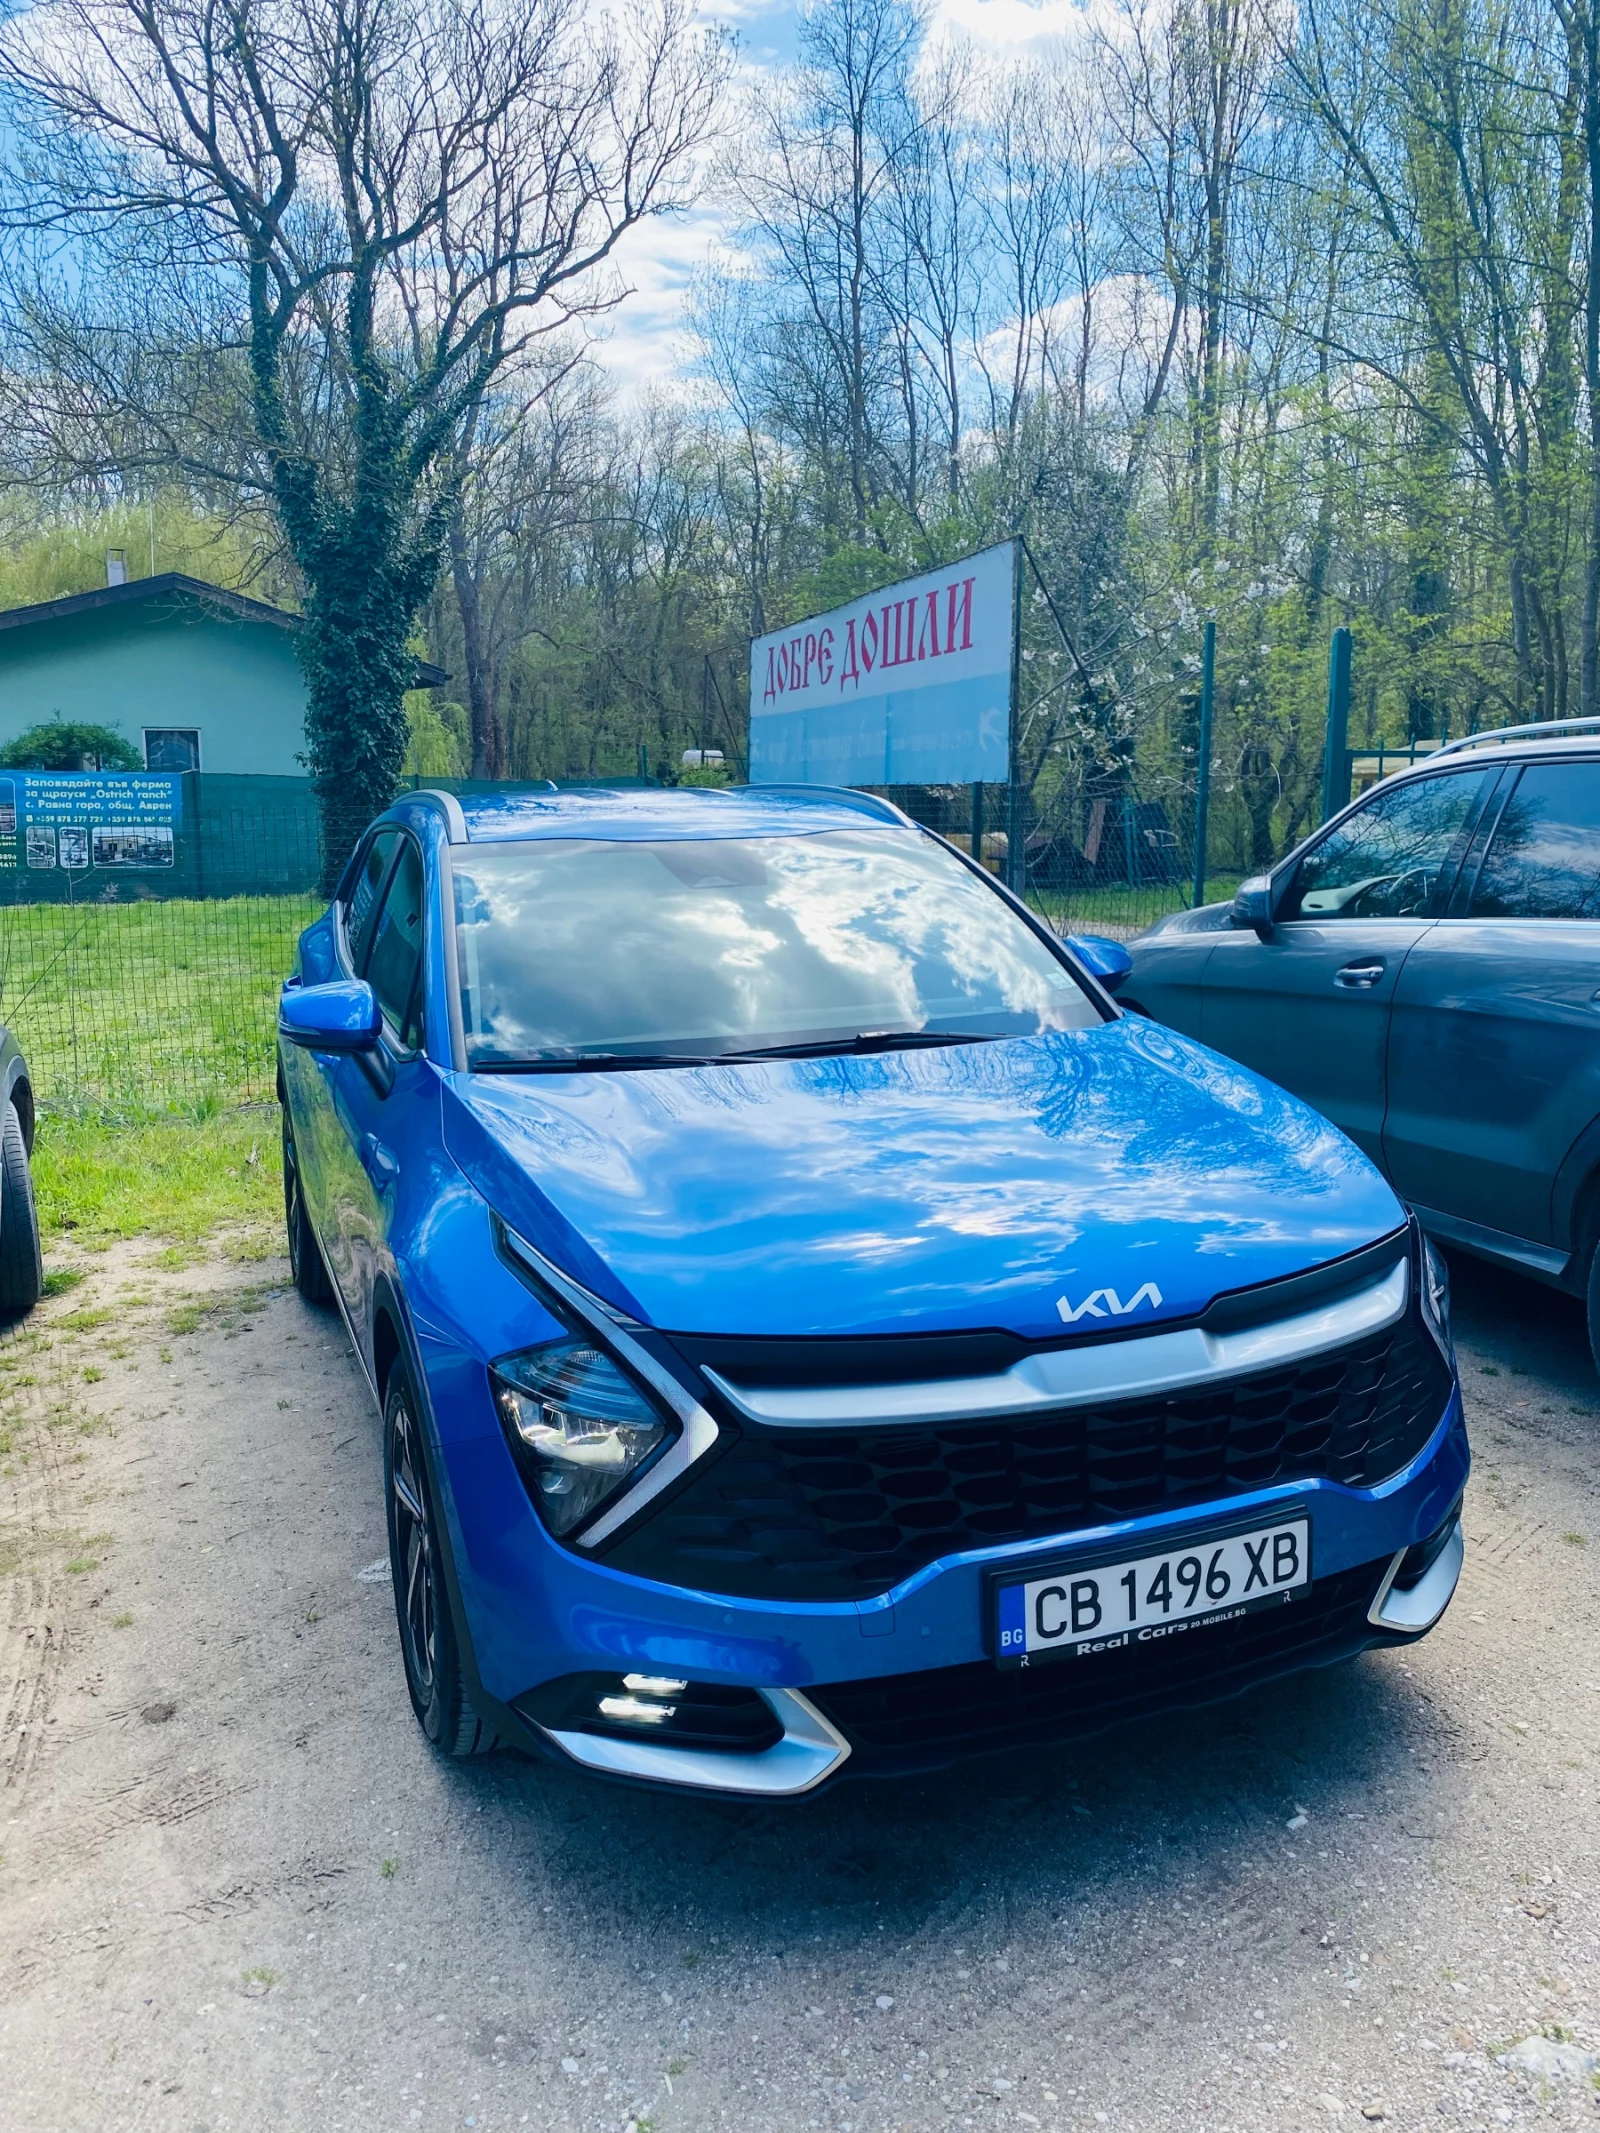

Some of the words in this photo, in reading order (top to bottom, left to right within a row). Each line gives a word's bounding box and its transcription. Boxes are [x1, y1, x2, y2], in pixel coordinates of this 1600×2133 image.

[764, 628, 835, 706] ДОБРЕ
[840, 577, 976, 693] ДОШЛИ
[24, 777, 103, 789] Заповядайте
[132, 779, 172, 790] ферма
[42, 790, 87, 799] щрауси
[38, 800, 73, 809] Равна
[76, 802, 104, 811] гора,
[108, 800, 135, 810] общ.
[139, 801, 172, 810] Аврен
[1120, 1548, 1231, 1621] 1496
[1001, 1629, 1023, 1647] BG
[1076, 1633, 1129, 1656] Real
[1137, 1622, 1189, 1641] Cars
